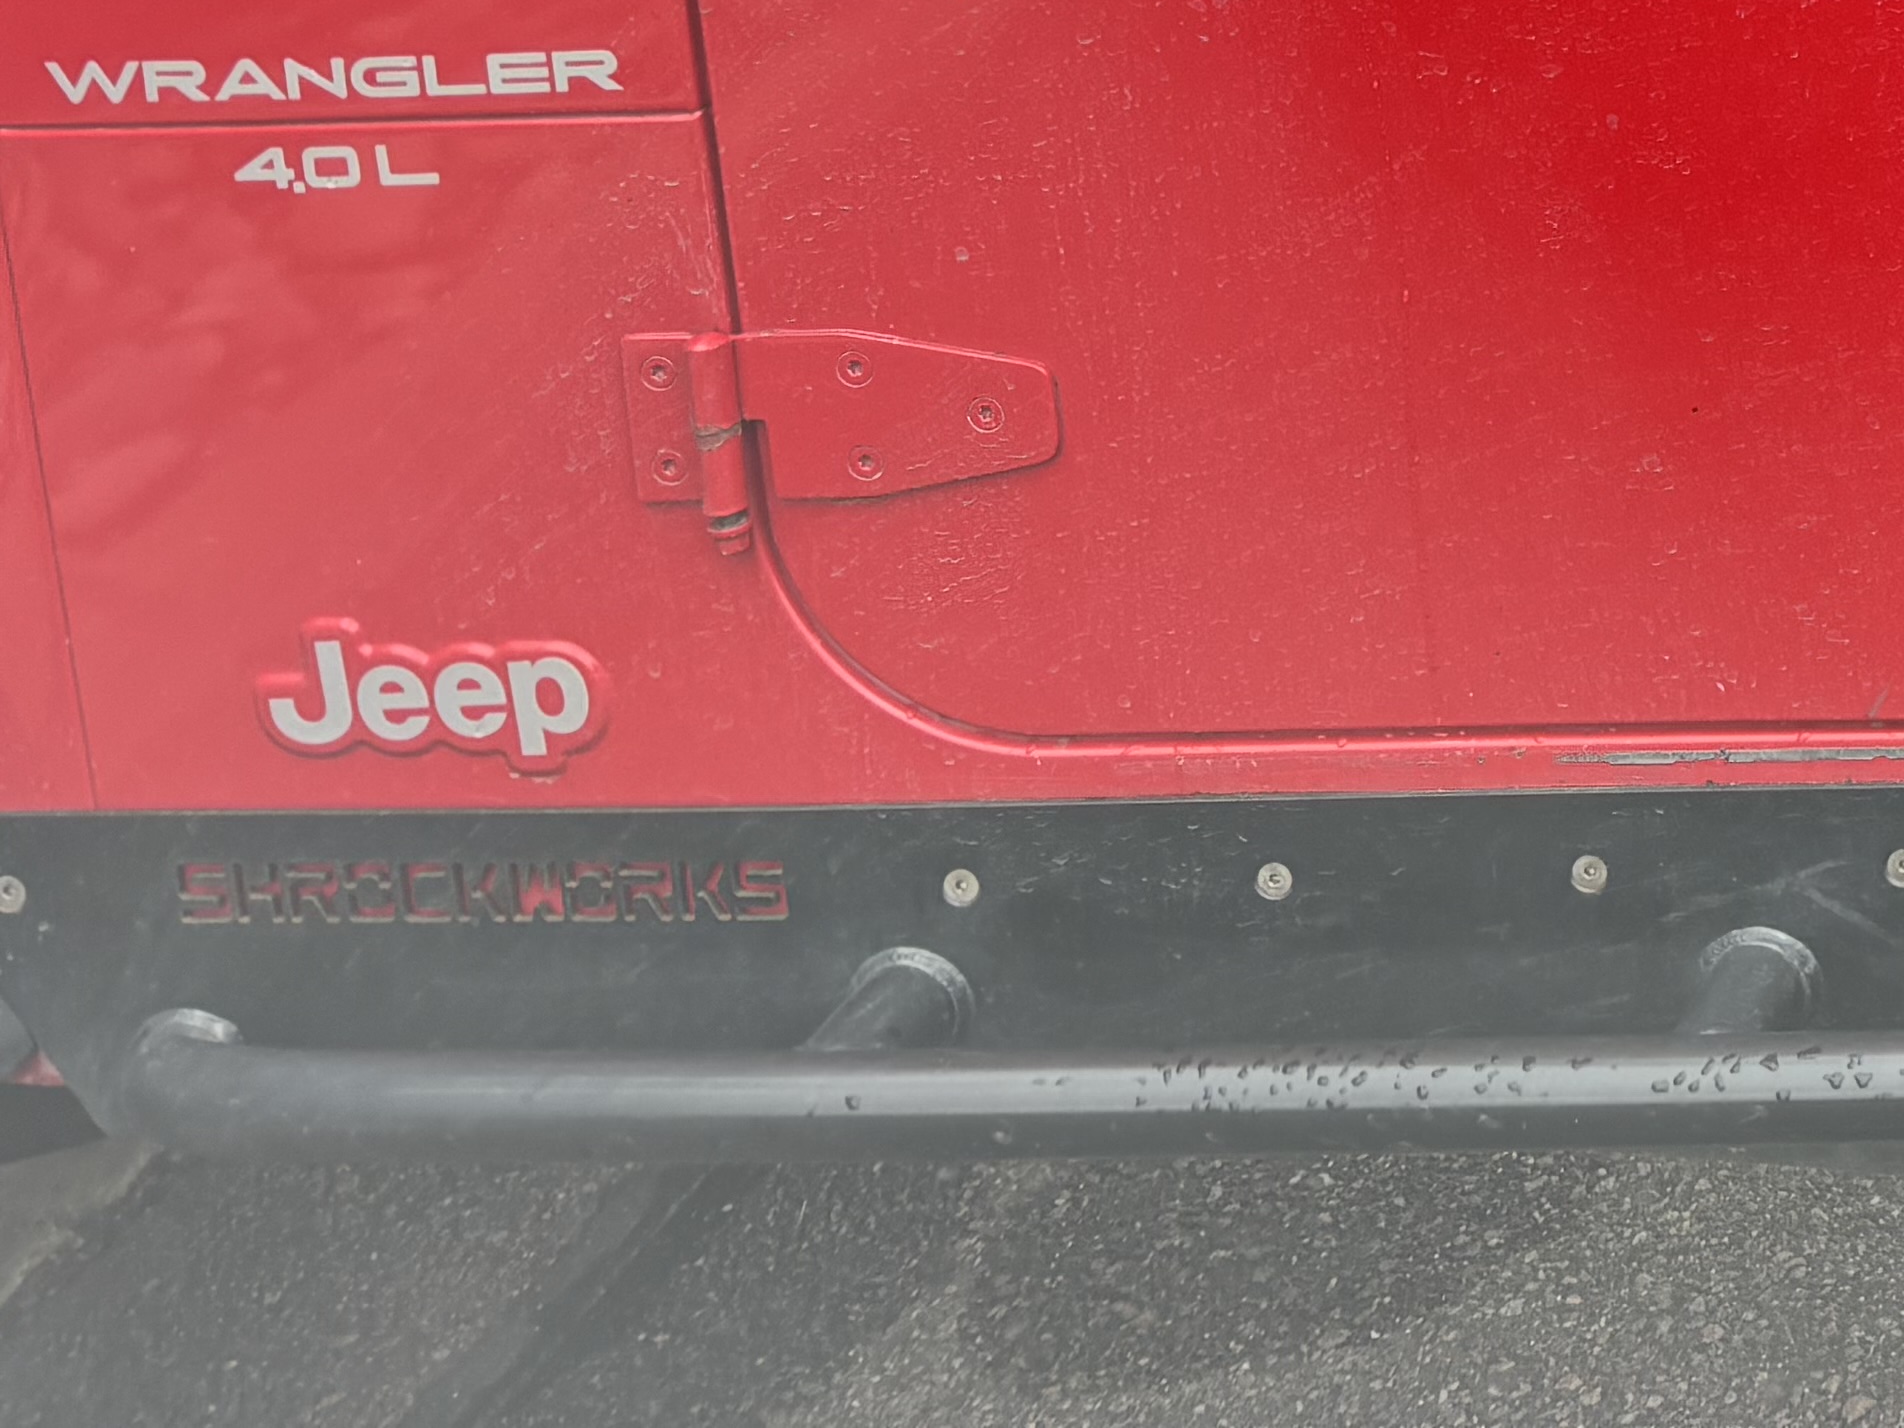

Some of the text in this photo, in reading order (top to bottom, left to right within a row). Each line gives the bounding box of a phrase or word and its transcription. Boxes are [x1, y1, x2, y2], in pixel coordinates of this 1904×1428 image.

[44, 49, 624, 105] WRANGLER
[268, 640, 590, 756] Jeep
[177, 860, 790, 925] SHROCKWORKS
